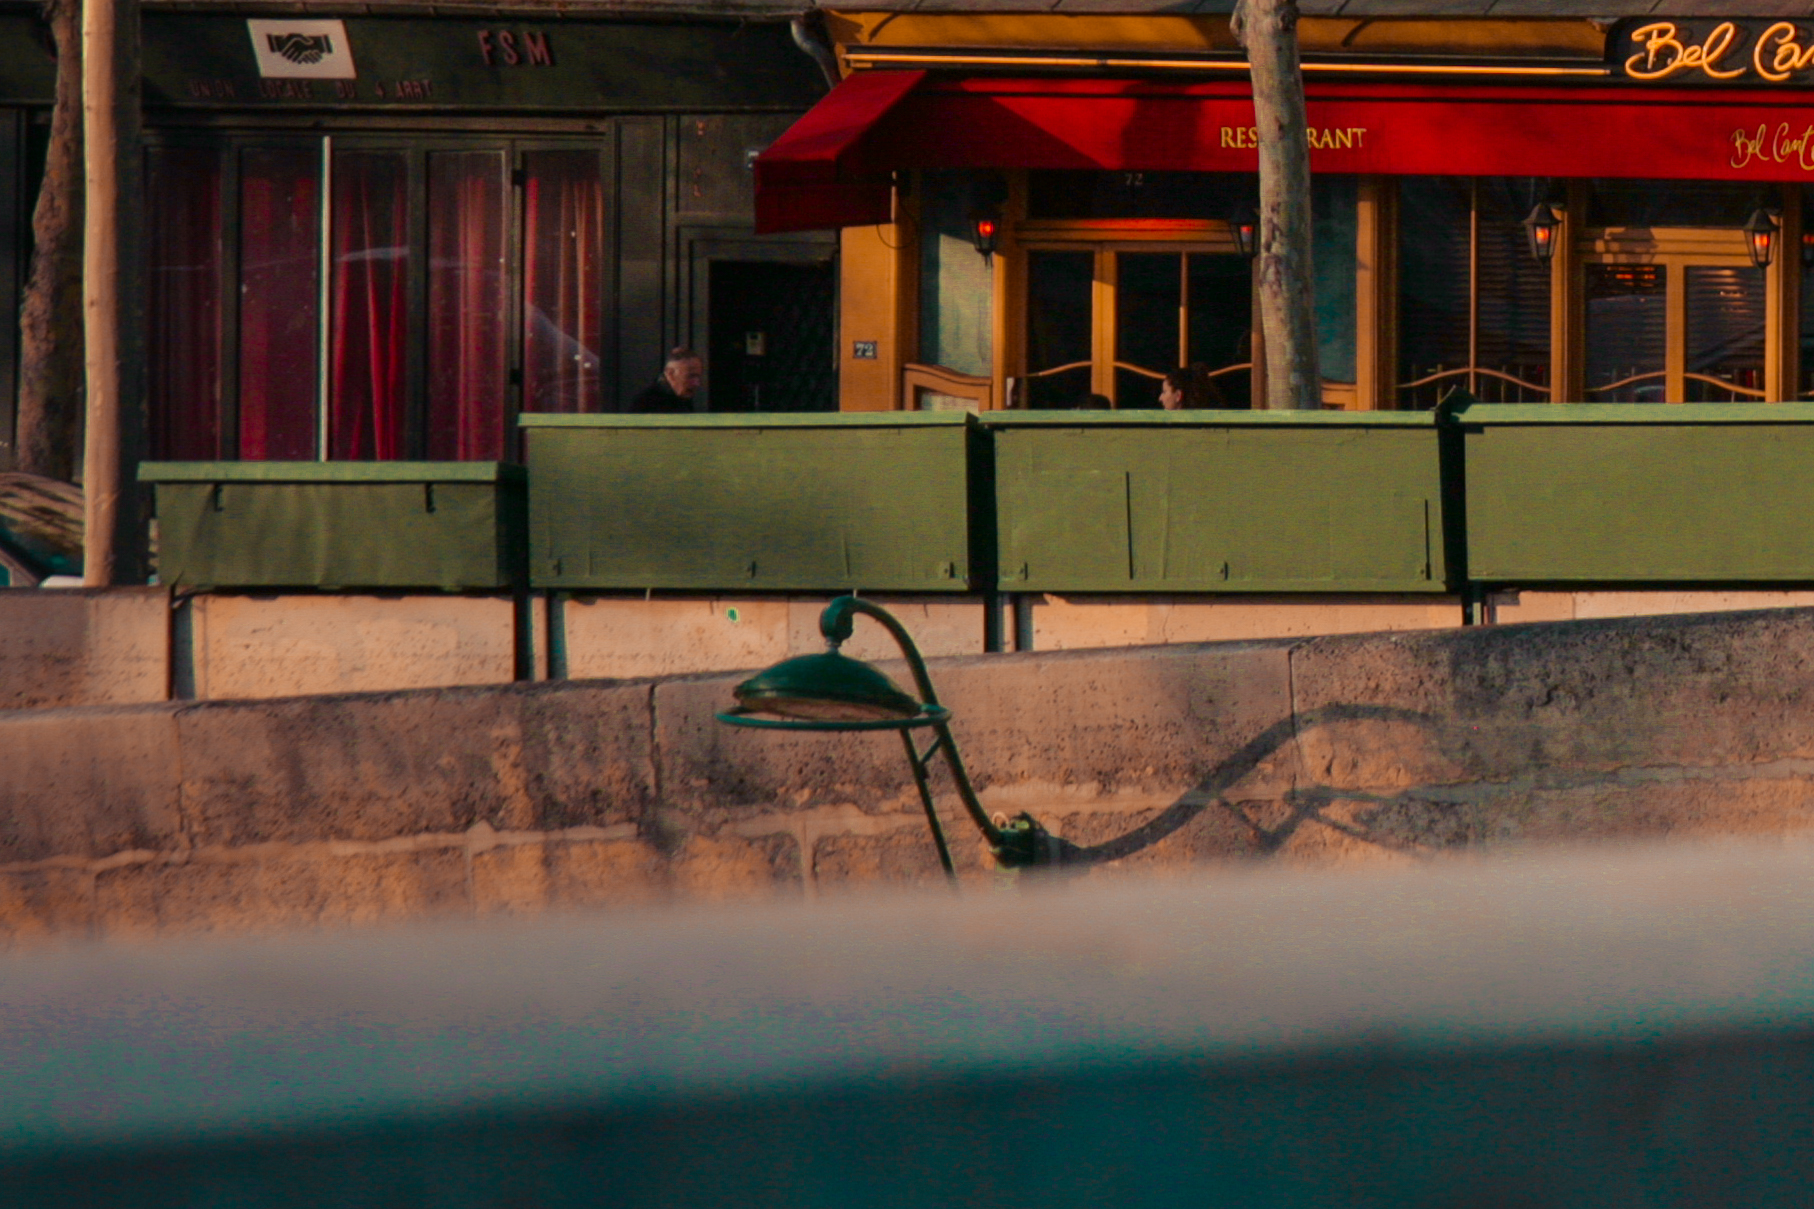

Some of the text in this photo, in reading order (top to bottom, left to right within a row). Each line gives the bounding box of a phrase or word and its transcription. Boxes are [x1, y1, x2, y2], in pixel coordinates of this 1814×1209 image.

[477, 29, 554, 66] FSM
[1625, 21, 1746, 79] Bel
[1221, 126, 1367, 150] RESRANT
[1730, 123, 1770, 169] Bel
[855, 342, 874, 357] 72
